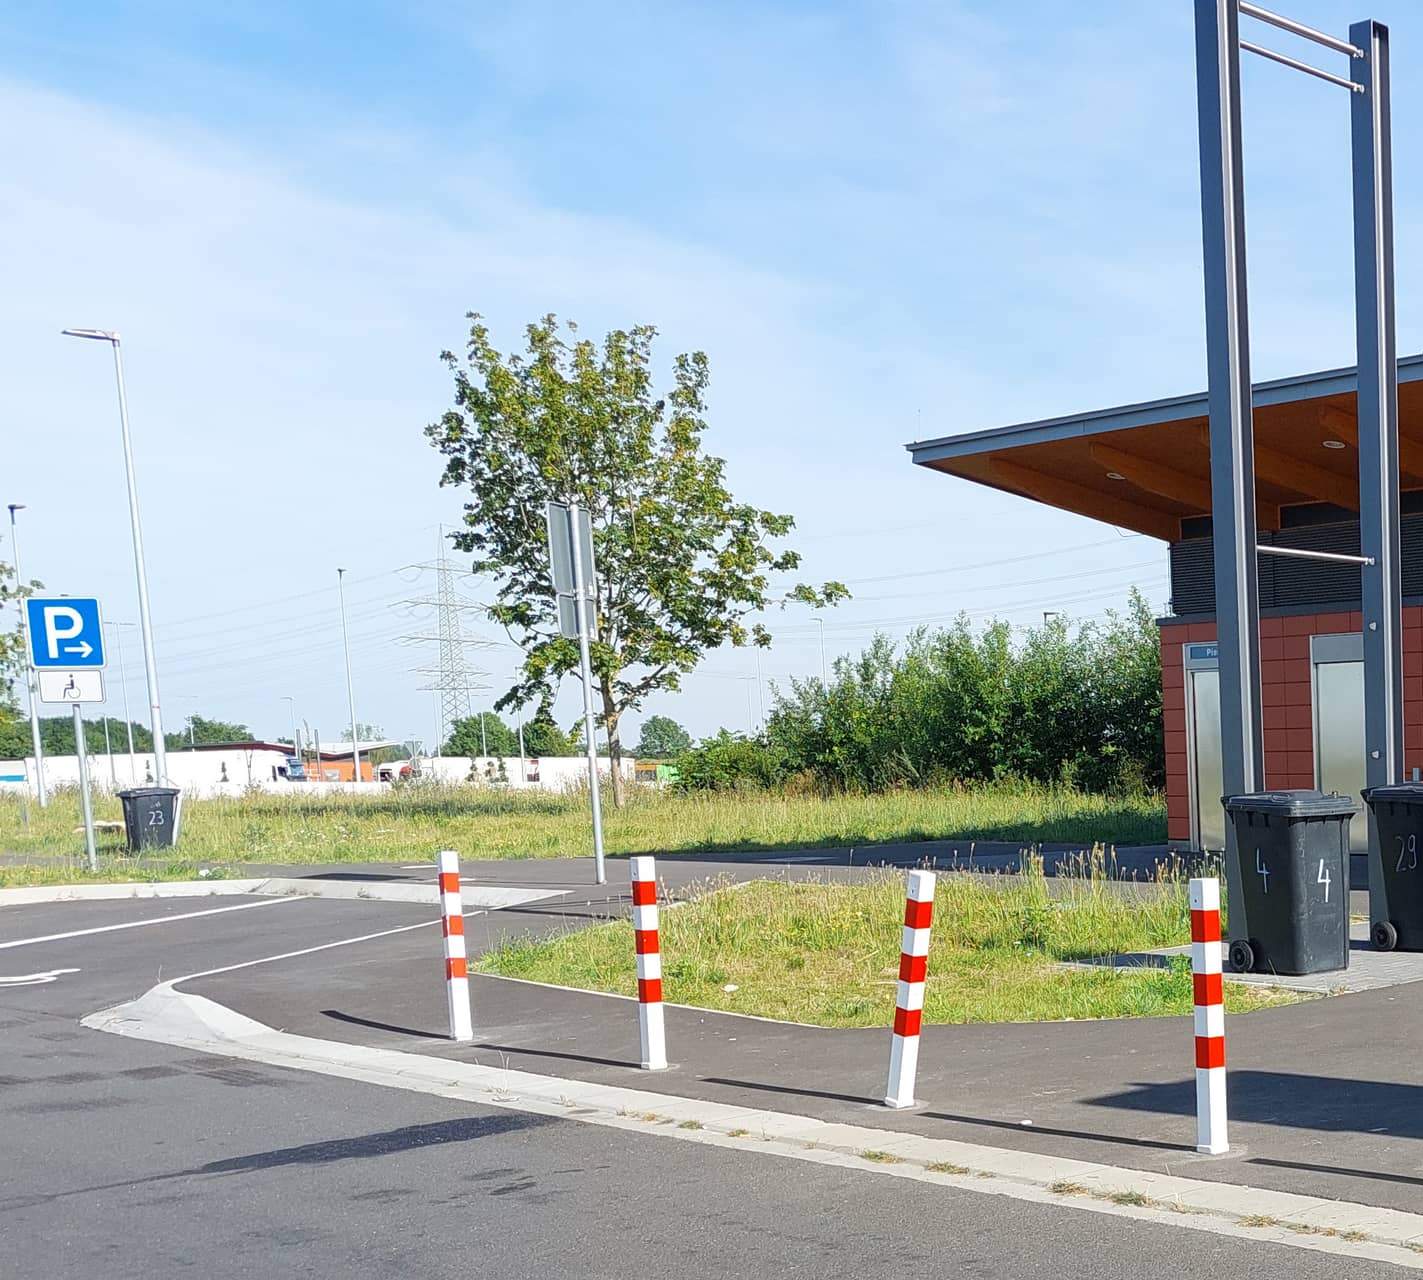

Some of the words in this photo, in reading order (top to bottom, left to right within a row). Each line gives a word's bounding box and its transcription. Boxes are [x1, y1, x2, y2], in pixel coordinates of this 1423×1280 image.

[43, 606, 83, 659] P
[148, 810, 165, 826] 23
[1256, 847, 1271, 894] 4
[1395, 834, 1417, 873] 29
[1317, 858, 1332, 903] 4
